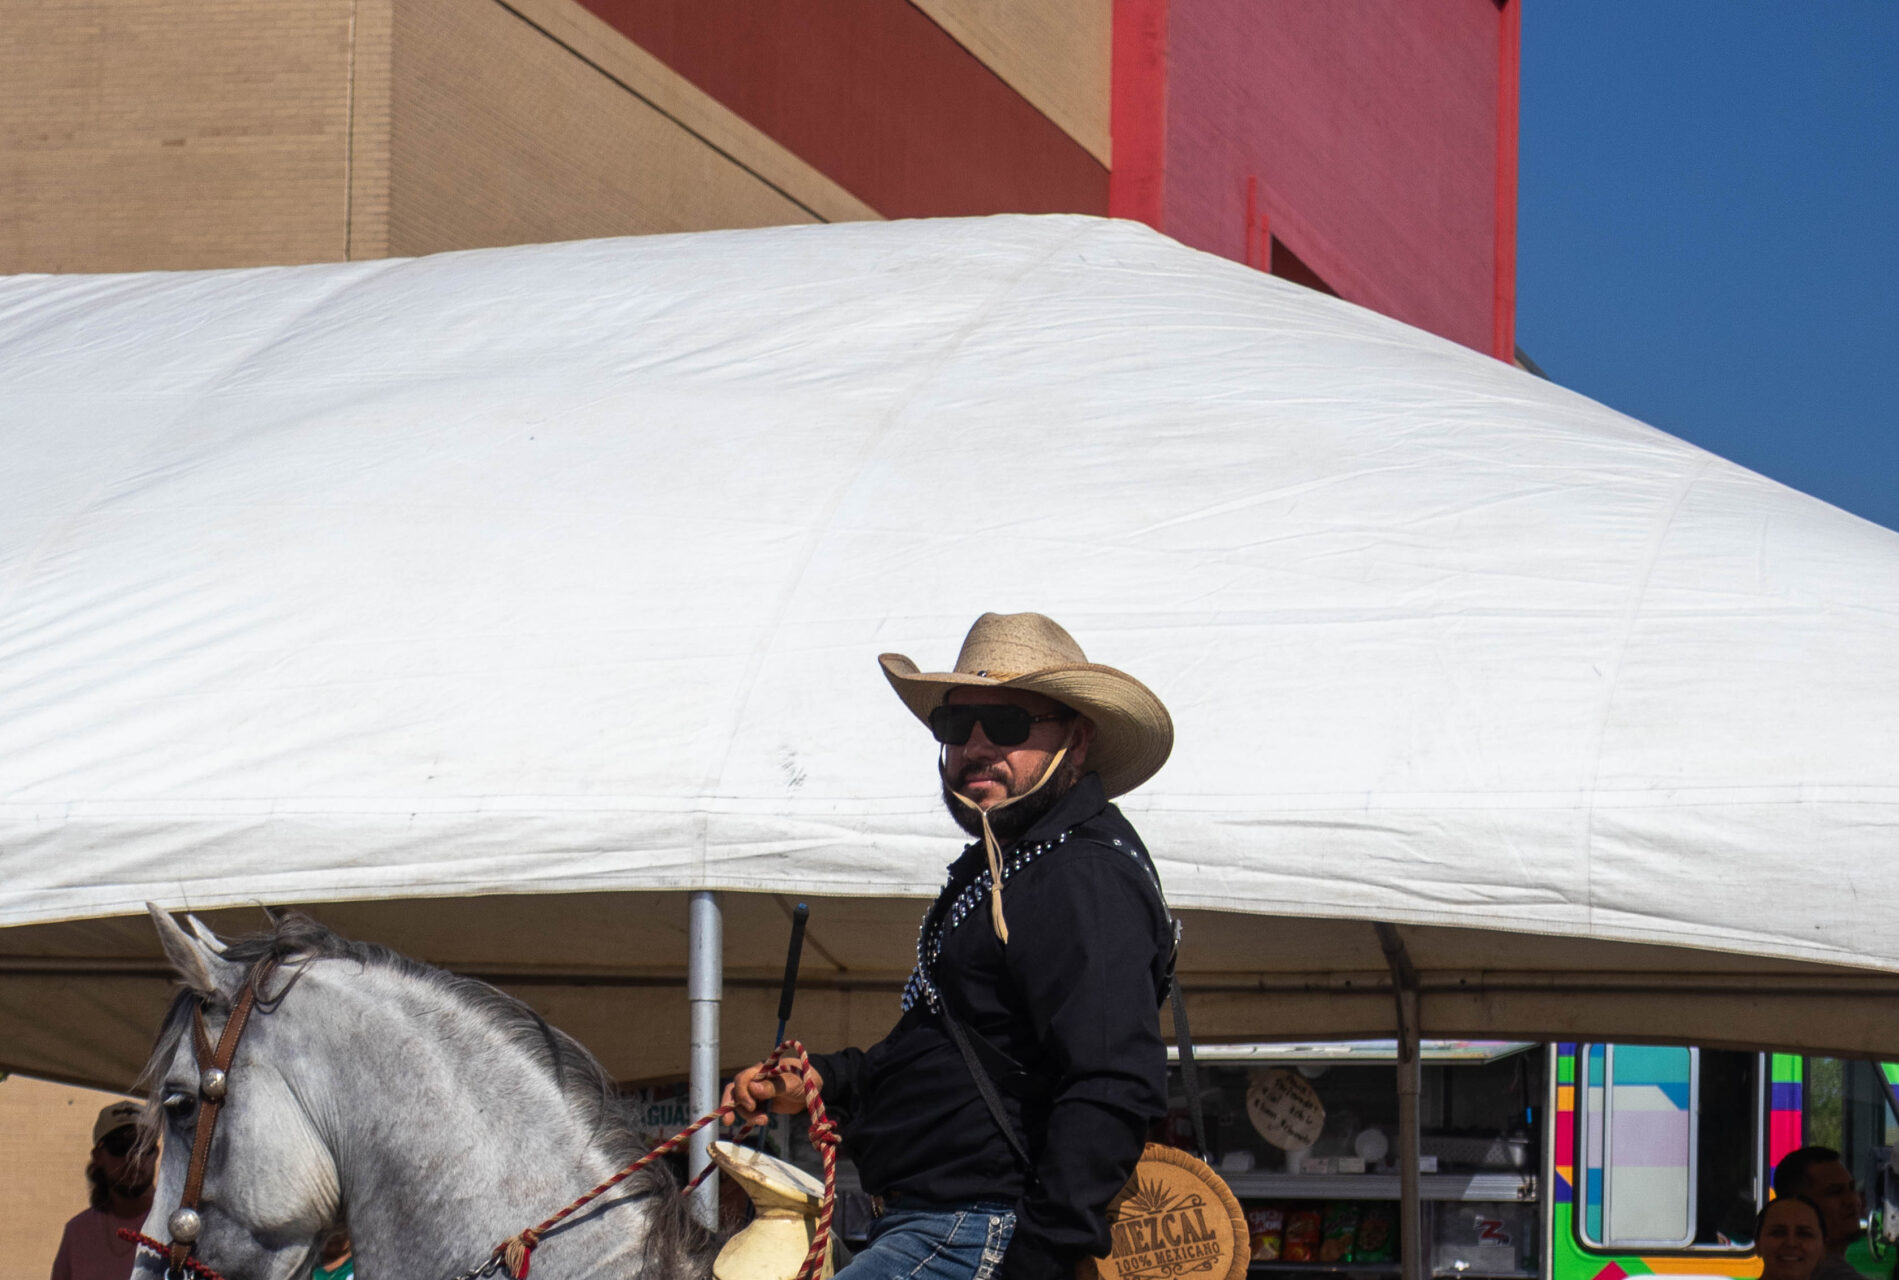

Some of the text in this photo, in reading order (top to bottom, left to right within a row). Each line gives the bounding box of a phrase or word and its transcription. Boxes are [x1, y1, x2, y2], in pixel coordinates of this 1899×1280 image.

[1111, 1208, 1216, 1259] MEZCAL
[1115, 1241, 1221, 1274] 100% MEXICANO
